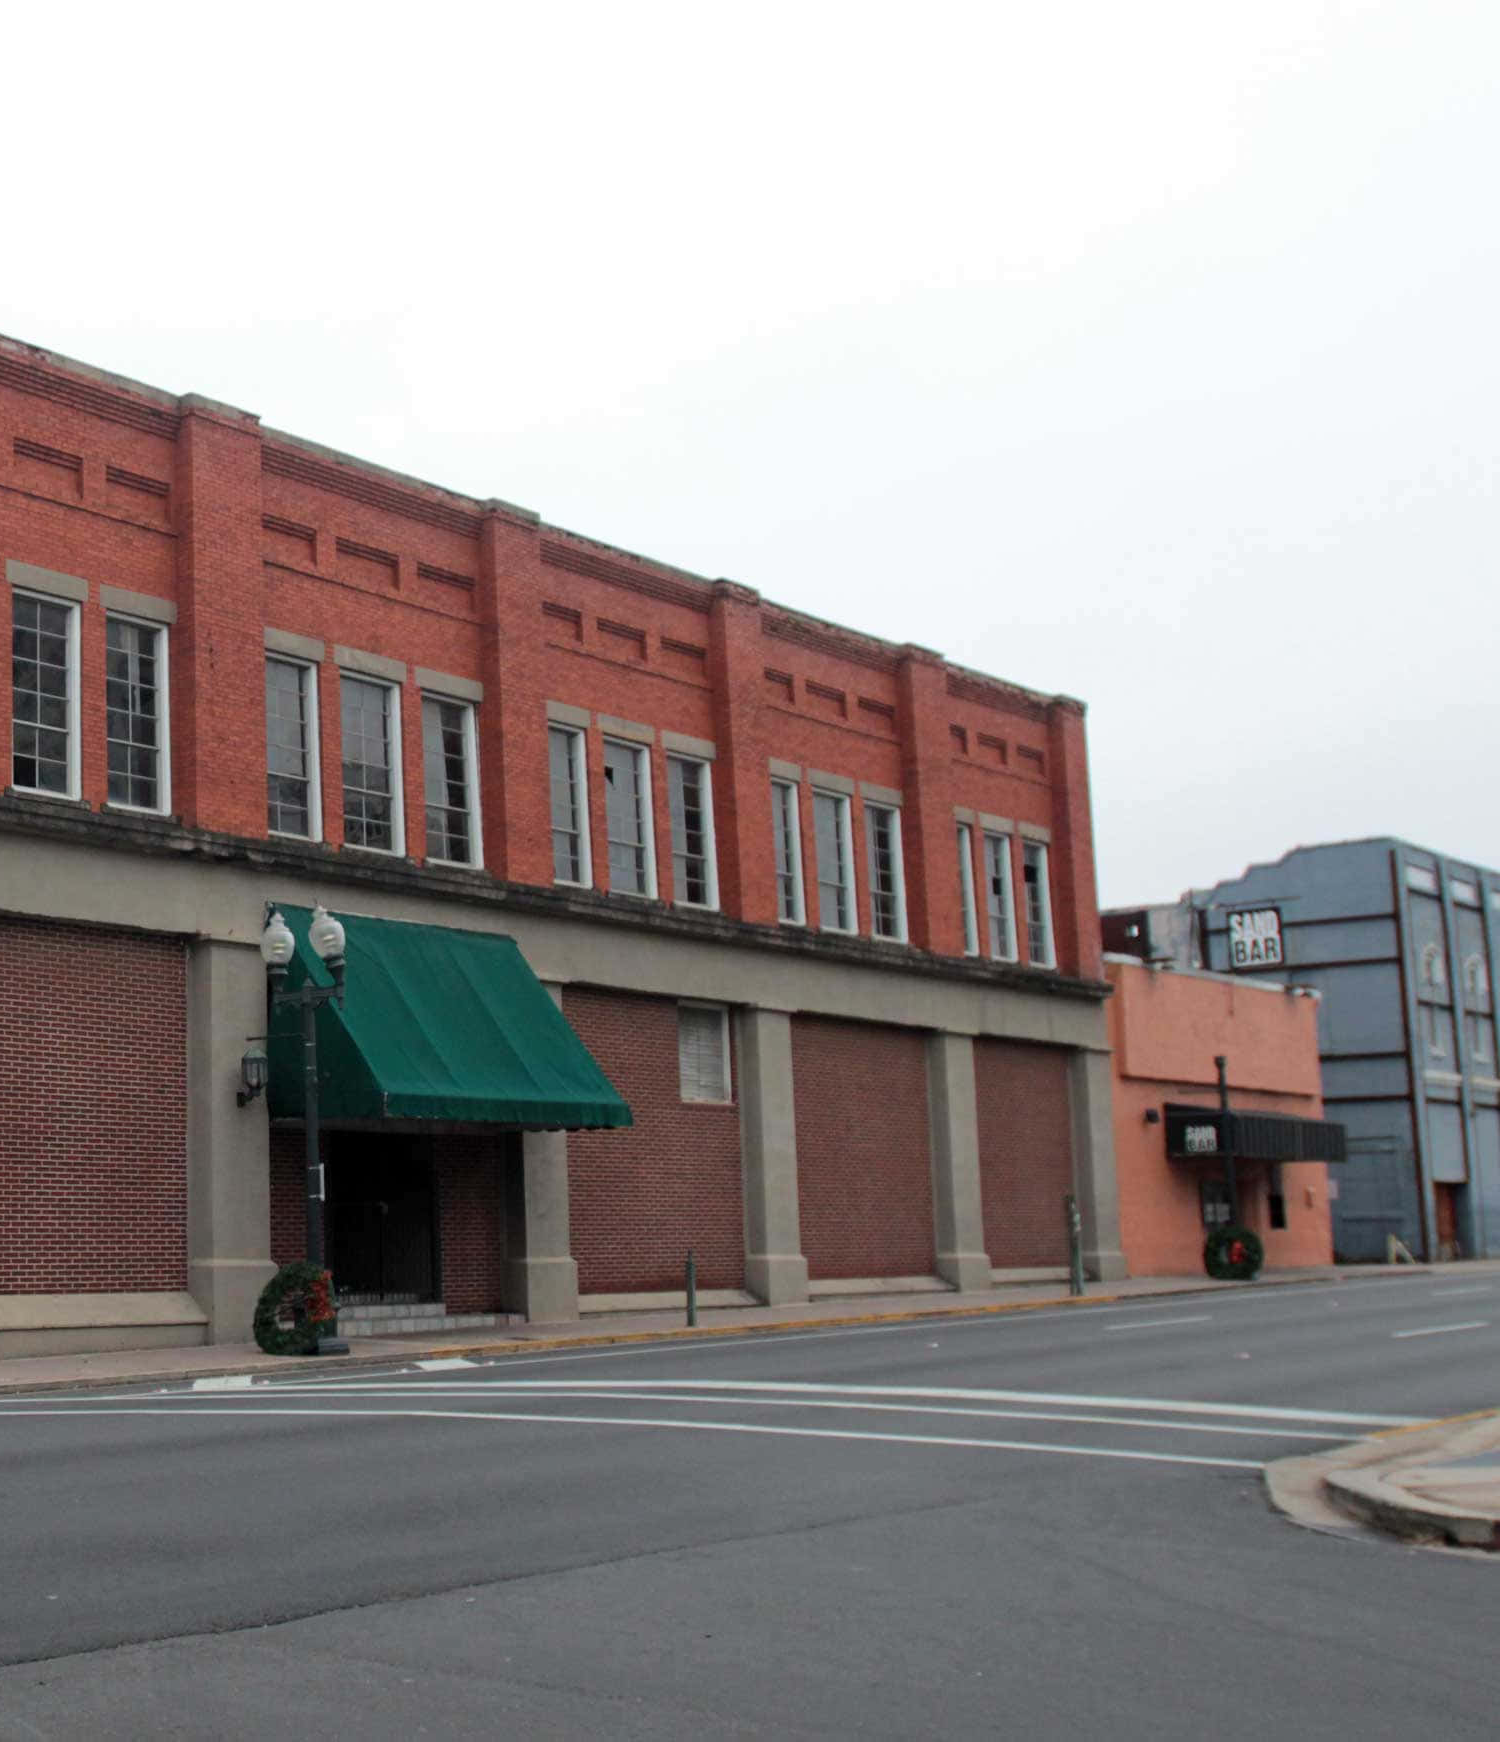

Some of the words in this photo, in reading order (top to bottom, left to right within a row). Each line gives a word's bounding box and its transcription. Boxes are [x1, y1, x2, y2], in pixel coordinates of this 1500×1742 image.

[1229, 910, 1278, 938] SAND
[1235, 937, 1277, 962] BAR
[1187, 1139, 1217, 1151] BAR
